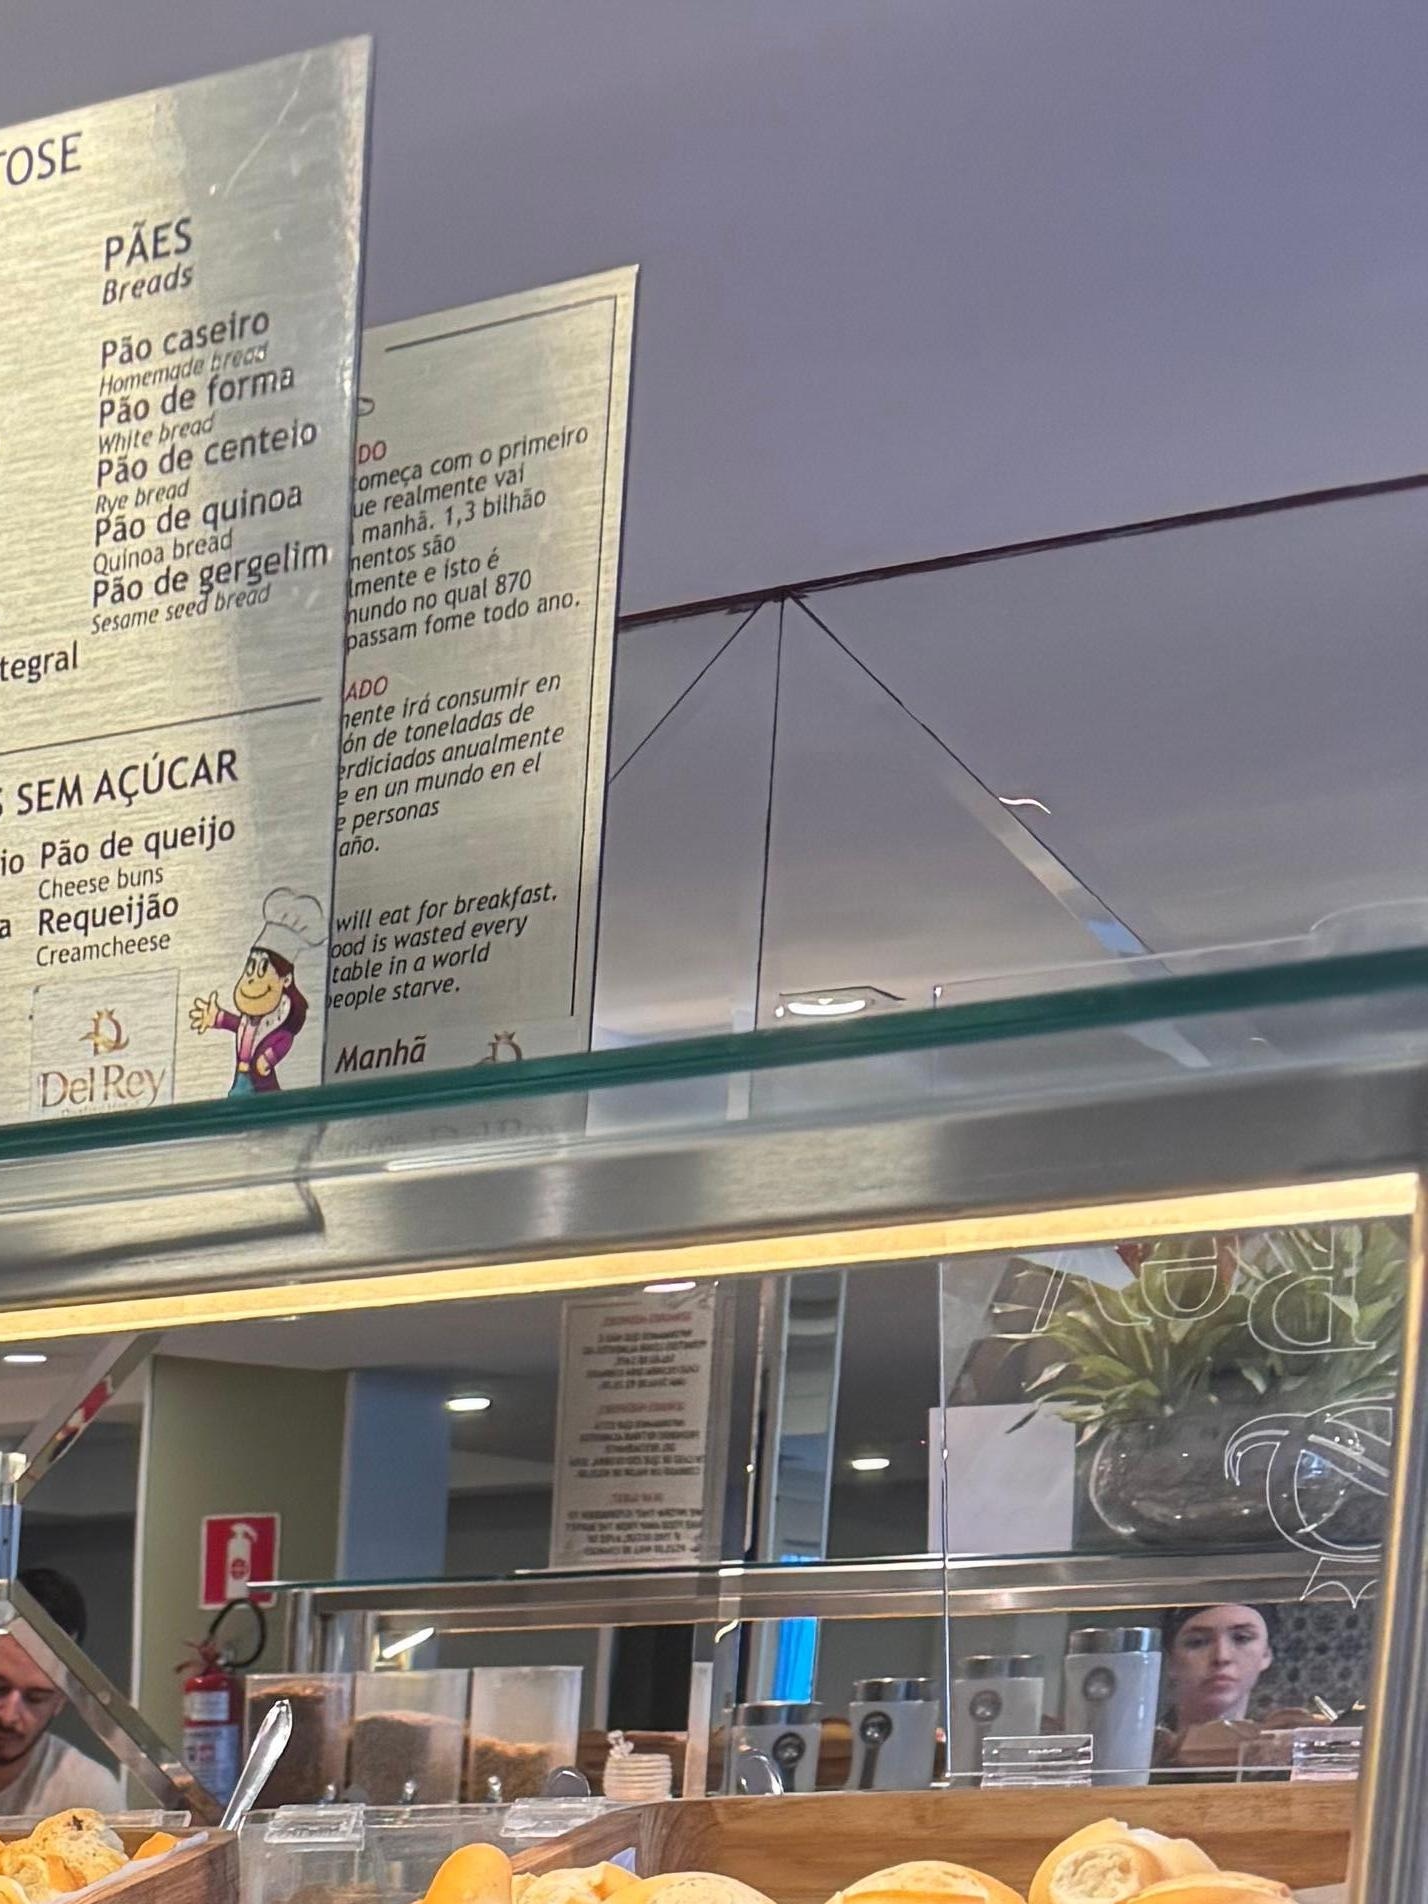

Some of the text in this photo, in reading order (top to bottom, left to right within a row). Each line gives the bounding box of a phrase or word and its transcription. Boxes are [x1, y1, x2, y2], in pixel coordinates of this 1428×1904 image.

[104, 215, 192, 272] PÃES
[101, 262, 193, 306] Breads
[100, 310, 270, 370] Pão caseiro
[96, 418, 317, 489] Pão de centeio
[357, 426, 588, 491] omeça com o primeiro
[94, 475, 191, 520] Rye bread
[382, 461, 525, 512] realmente vai
[361, 487, 546, 544] manhã. 1,3 bilhão
[92, 541, 328, 608] Pão de gergelim
[90, 582, 271, 635] Sesame seed bread
[346, 591, 580, 656] passam fome todo ano.
[440, 725, 564, 763] anualmente
[16, 773, 83, 816] SEM
[92, 747, 238, 808] AÇÚCAR
[353, 750, 542, 803] en un mundo en el
[40, 815, 236, 870] Pão de queijo
[37, 864, 164, 901] Cheese buns
[335, 881, 557, 933] will eat for breakfast.
[38, 891, 179, 937] Requeijão
[371, 914, 528, 953] is wasted every
[36, 930, 172, 968] Creamcheese
[391, 976, 460, 1000] starve.
[333, 1034, 427, 1074] Manhã
